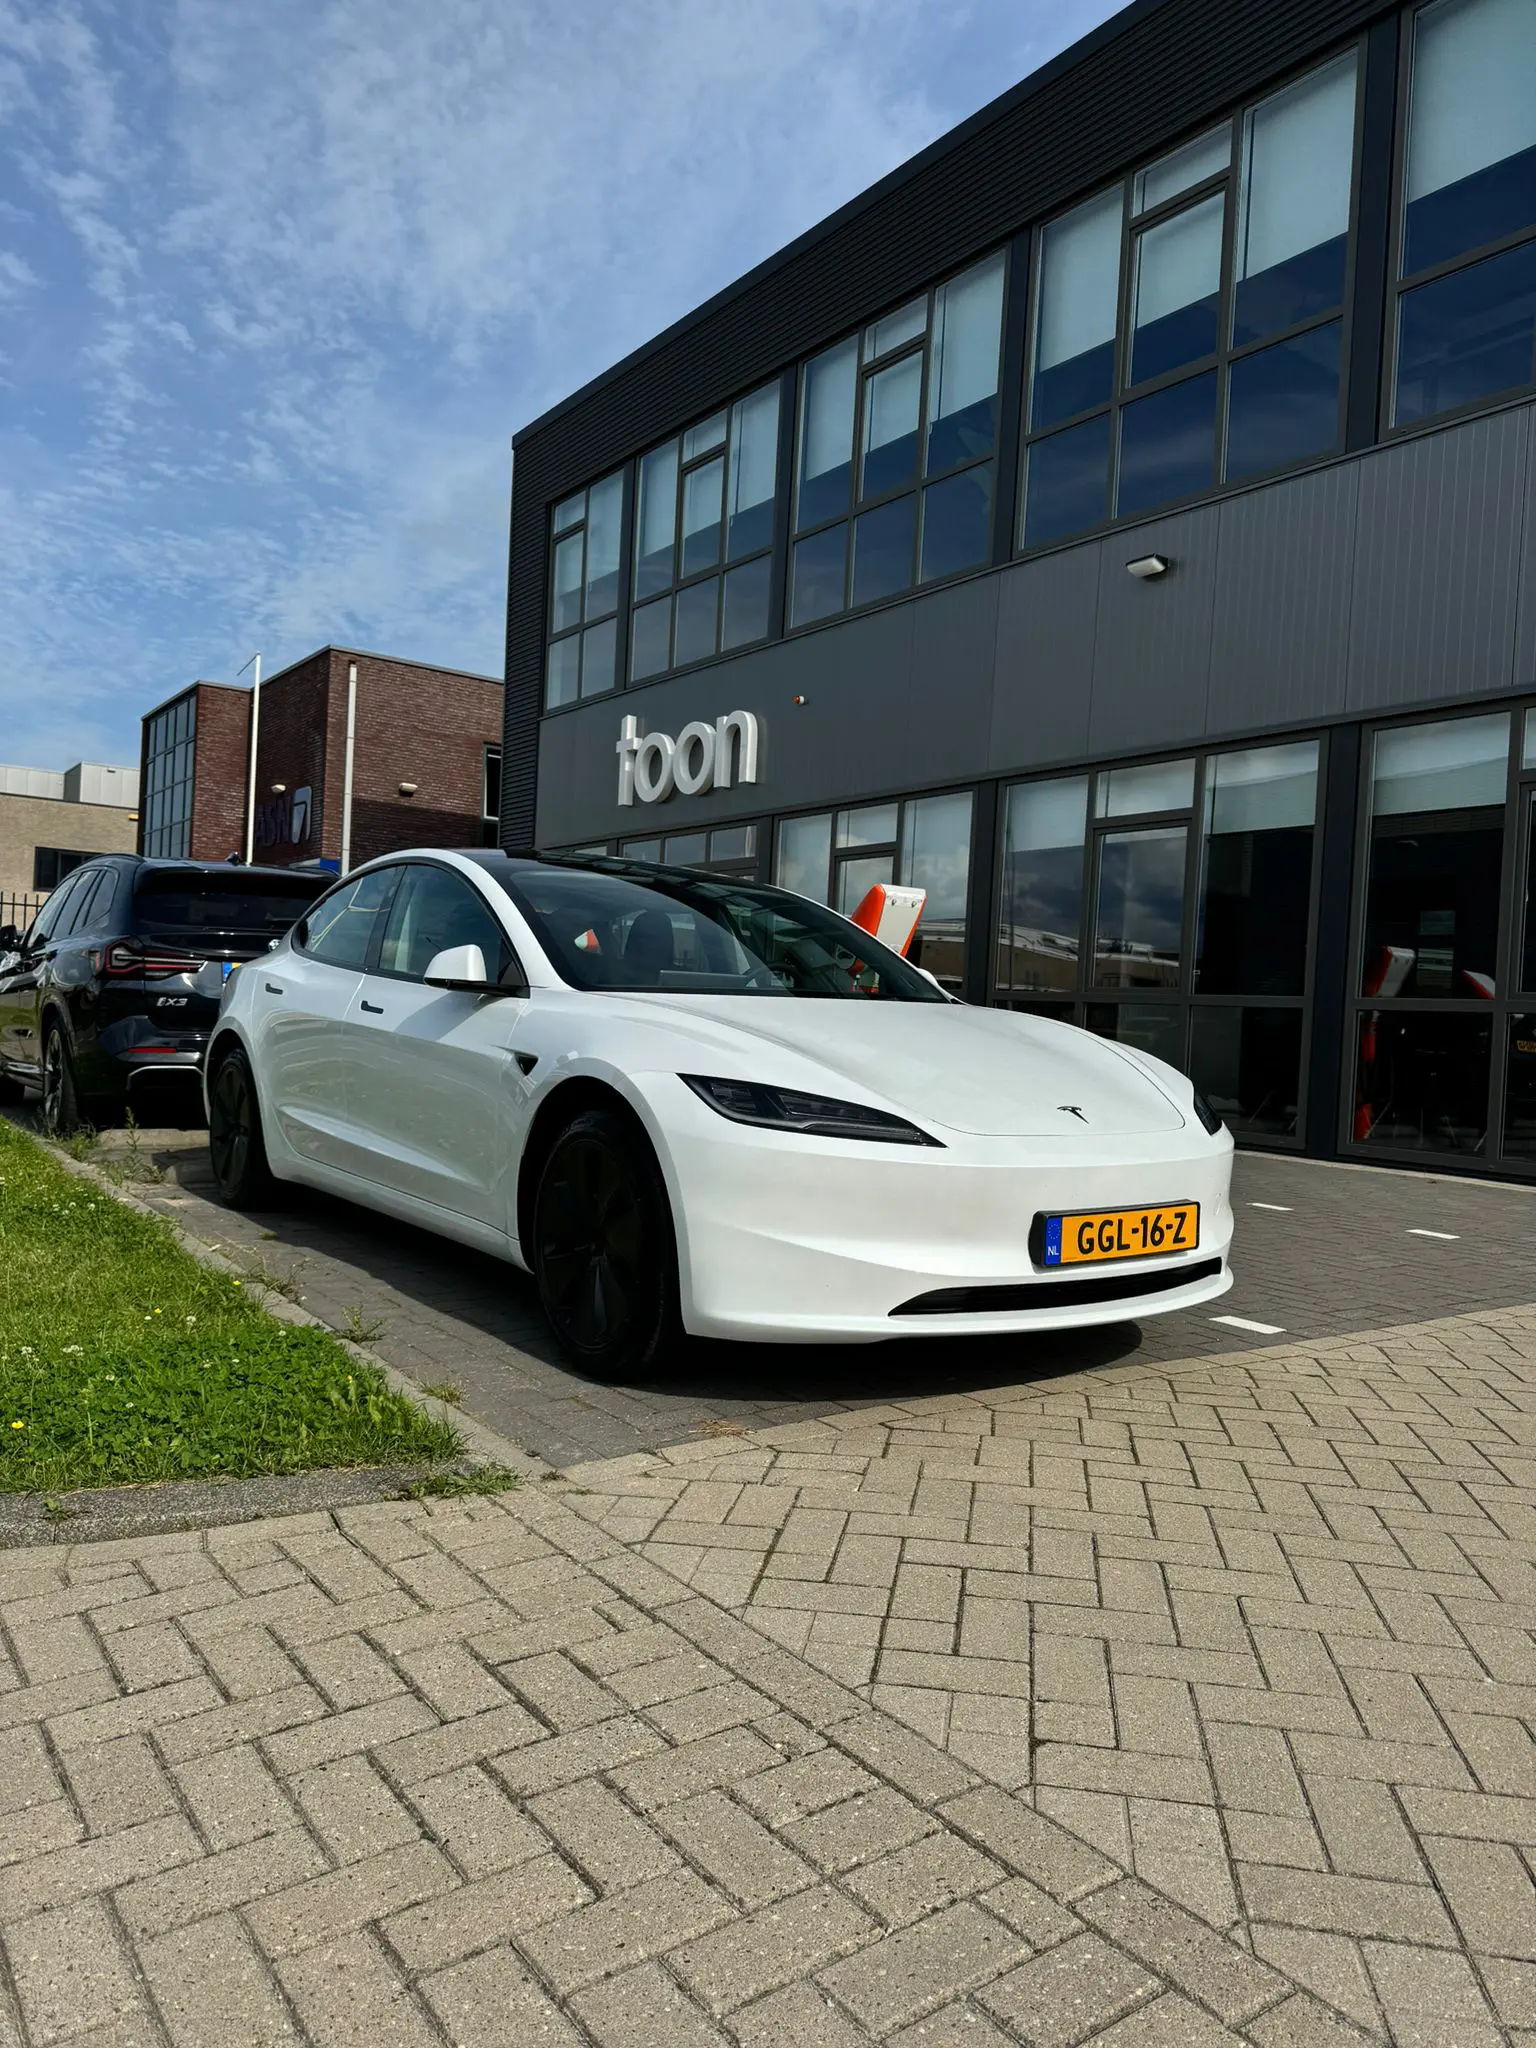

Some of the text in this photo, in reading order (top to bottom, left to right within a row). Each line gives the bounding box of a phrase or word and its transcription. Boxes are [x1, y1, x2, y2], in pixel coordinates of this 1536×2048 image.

[616, 710, 758, 806] toon
[1047, 1245, 1060, 1256] NL
[1077, 1212, 1187, 1254] GGL-16-Z
